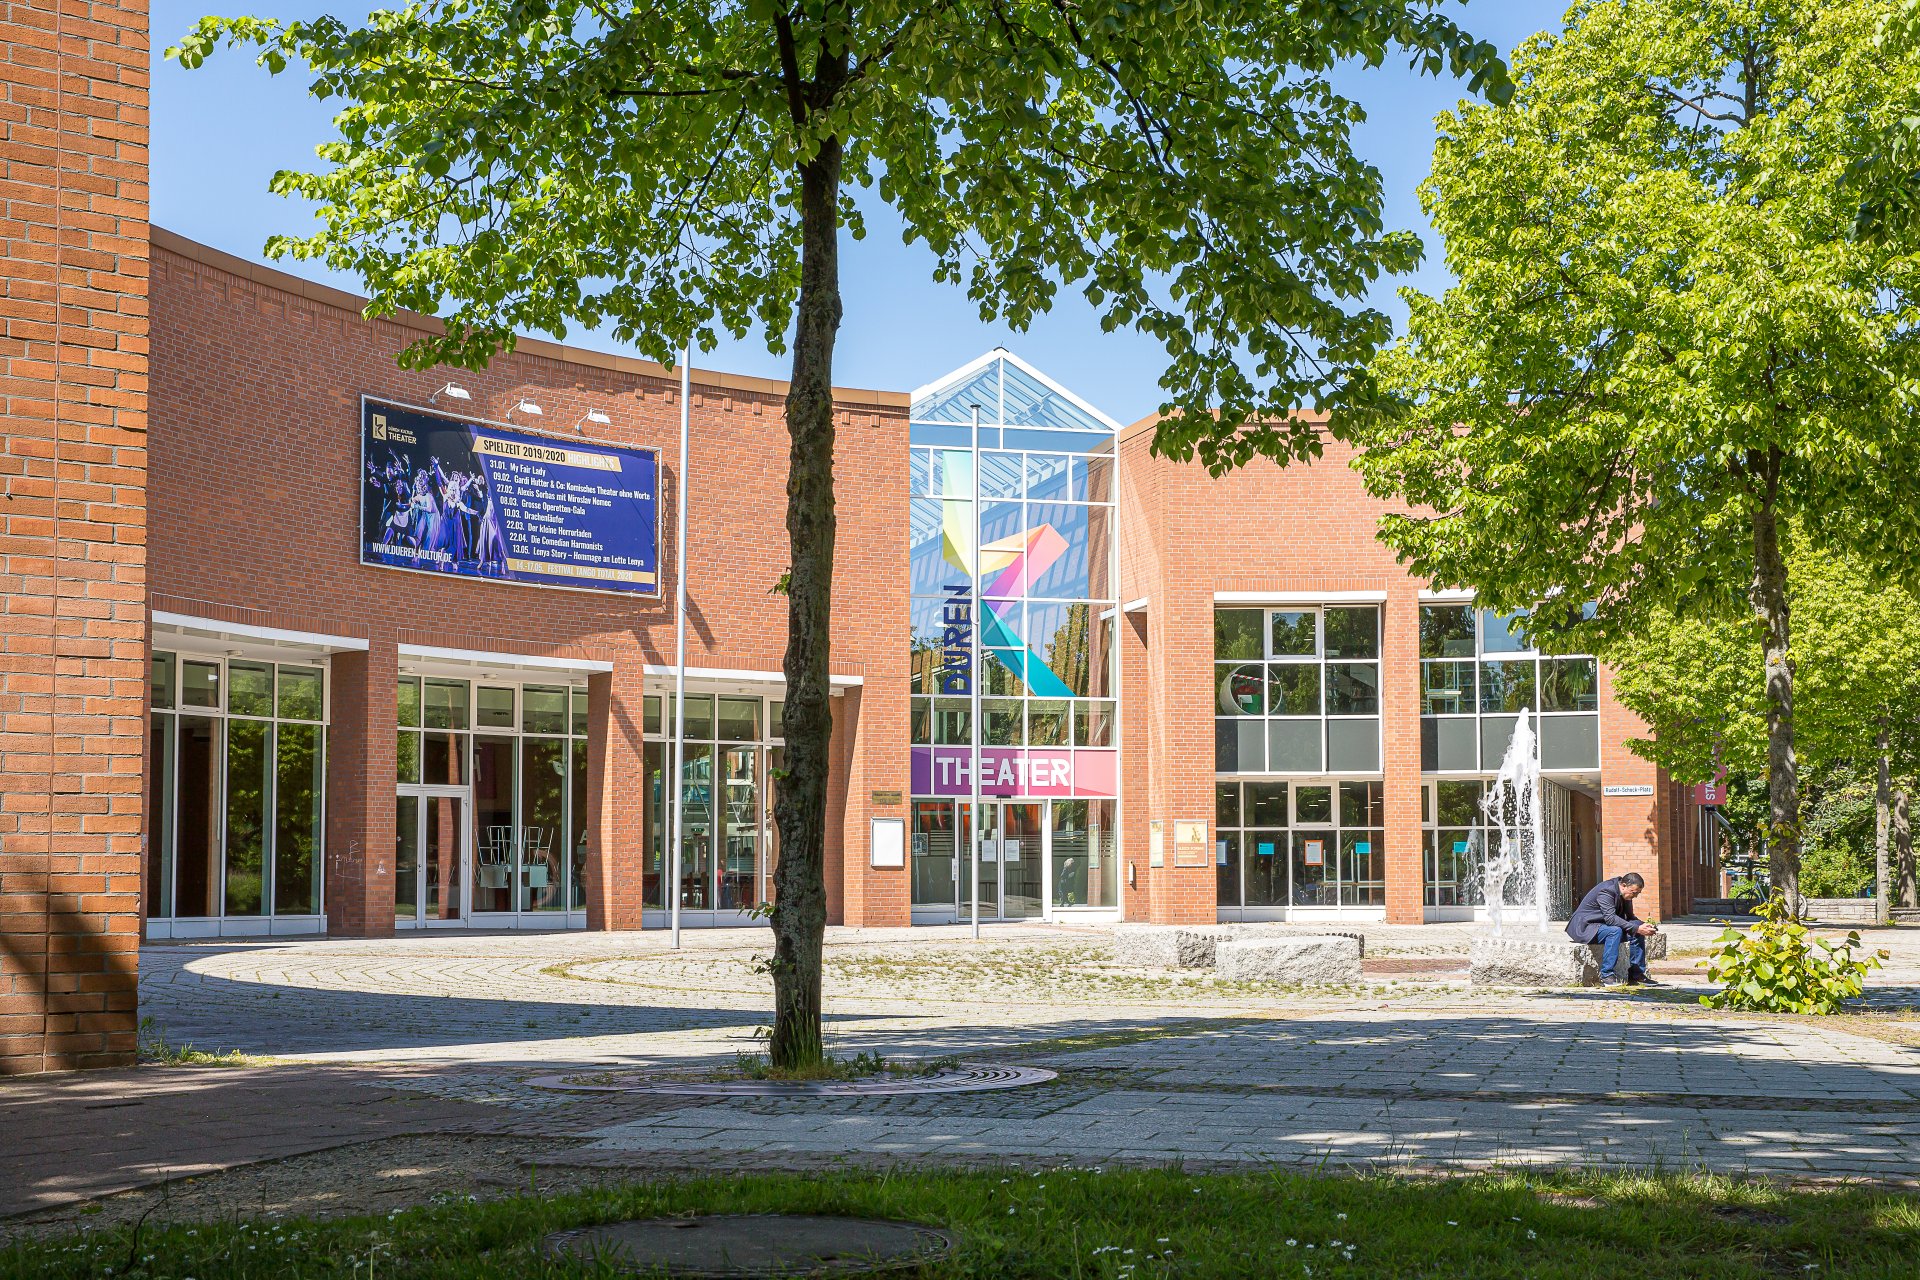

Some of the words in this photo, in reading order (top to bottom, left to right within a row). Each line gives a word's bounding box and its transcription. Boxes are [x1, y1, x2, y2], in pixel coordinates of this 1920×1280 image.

[388, 431, 417, 445] THEATER
[484, 440, 520, 456] SPIELZEIT
[523, 446, 566, 463] 2019/2020
[568, 452, 615, 469] HIGHLIGHTS
[490, 459, 507, 470] 31.01.
[510, 462, 519, 473] My
[520, 464, 531, 474] Fair
[532, 466, 546, 477] Lady
[493, 471, 511, 482] 09.02.
[514, 474, 530, 485] Gardi
[530, 476, 549, 487] Hutter
[550, 480, 555, 489] &
[556, 480, 566, 490] Co:
[567, 482, 596, 494] Komisches
[597, 485, 618, 497] Theater
[619, 489, 633, 499] ohne
[634, 490, 650, 501] Worte
[496, 483, 514, 495] 27.02.
[517, 486, 534, 498] Alexis
[536, 489, 555, 500] Sorbas
[556, 491, 566, 502] mit
[568, 494, 591, 505] Miroslav
[592, 497, 612, 507] Nemec
[500, 495, 518, 507] 08.03.
[521, 499, 541, 510] Grosse
[542, 501, 586, 515] Operetten-Gala
[503, 508, 521, 519] 10.03.
[524, 510, 564, 524] Drachenläufer
[506, 520, 525, 531] 22.03.
[527, 522, 538, 532] Der
[539, 524, 557, 535] kleine
[558, 527, 592, 539] Horrorladen
[509, 532, 528, 543] 22.04.
[530, 534, 540, 544] Die
[541, 536, 570, 548] Comedian
[570, 540, 603, 551] Harmonists
[372, 542, 452, 562] WWW.DUEREN-KULTUR.DE
[512, 544, 530, 555] 13.05.
[533, 546, 550, 558] Lenya
[551, 548, 567, 560] Story
[573, 551, 602, 563] Hommage
[611, 555, 627, 565] Lotte
[627, 556, 644, 568] Lenya
[516, 561, 544, 573] 14.-17.05.
[547, 564, 574, 575] FESTIVAL
[576, 567, 596, 577] TANGO
[597, 569, 616, 579] TOTAL
[617, 571, 633, 581] 2020
[943, 585, 972, 695] DÜREN
[936, 757, 1071, 787] THEATER
